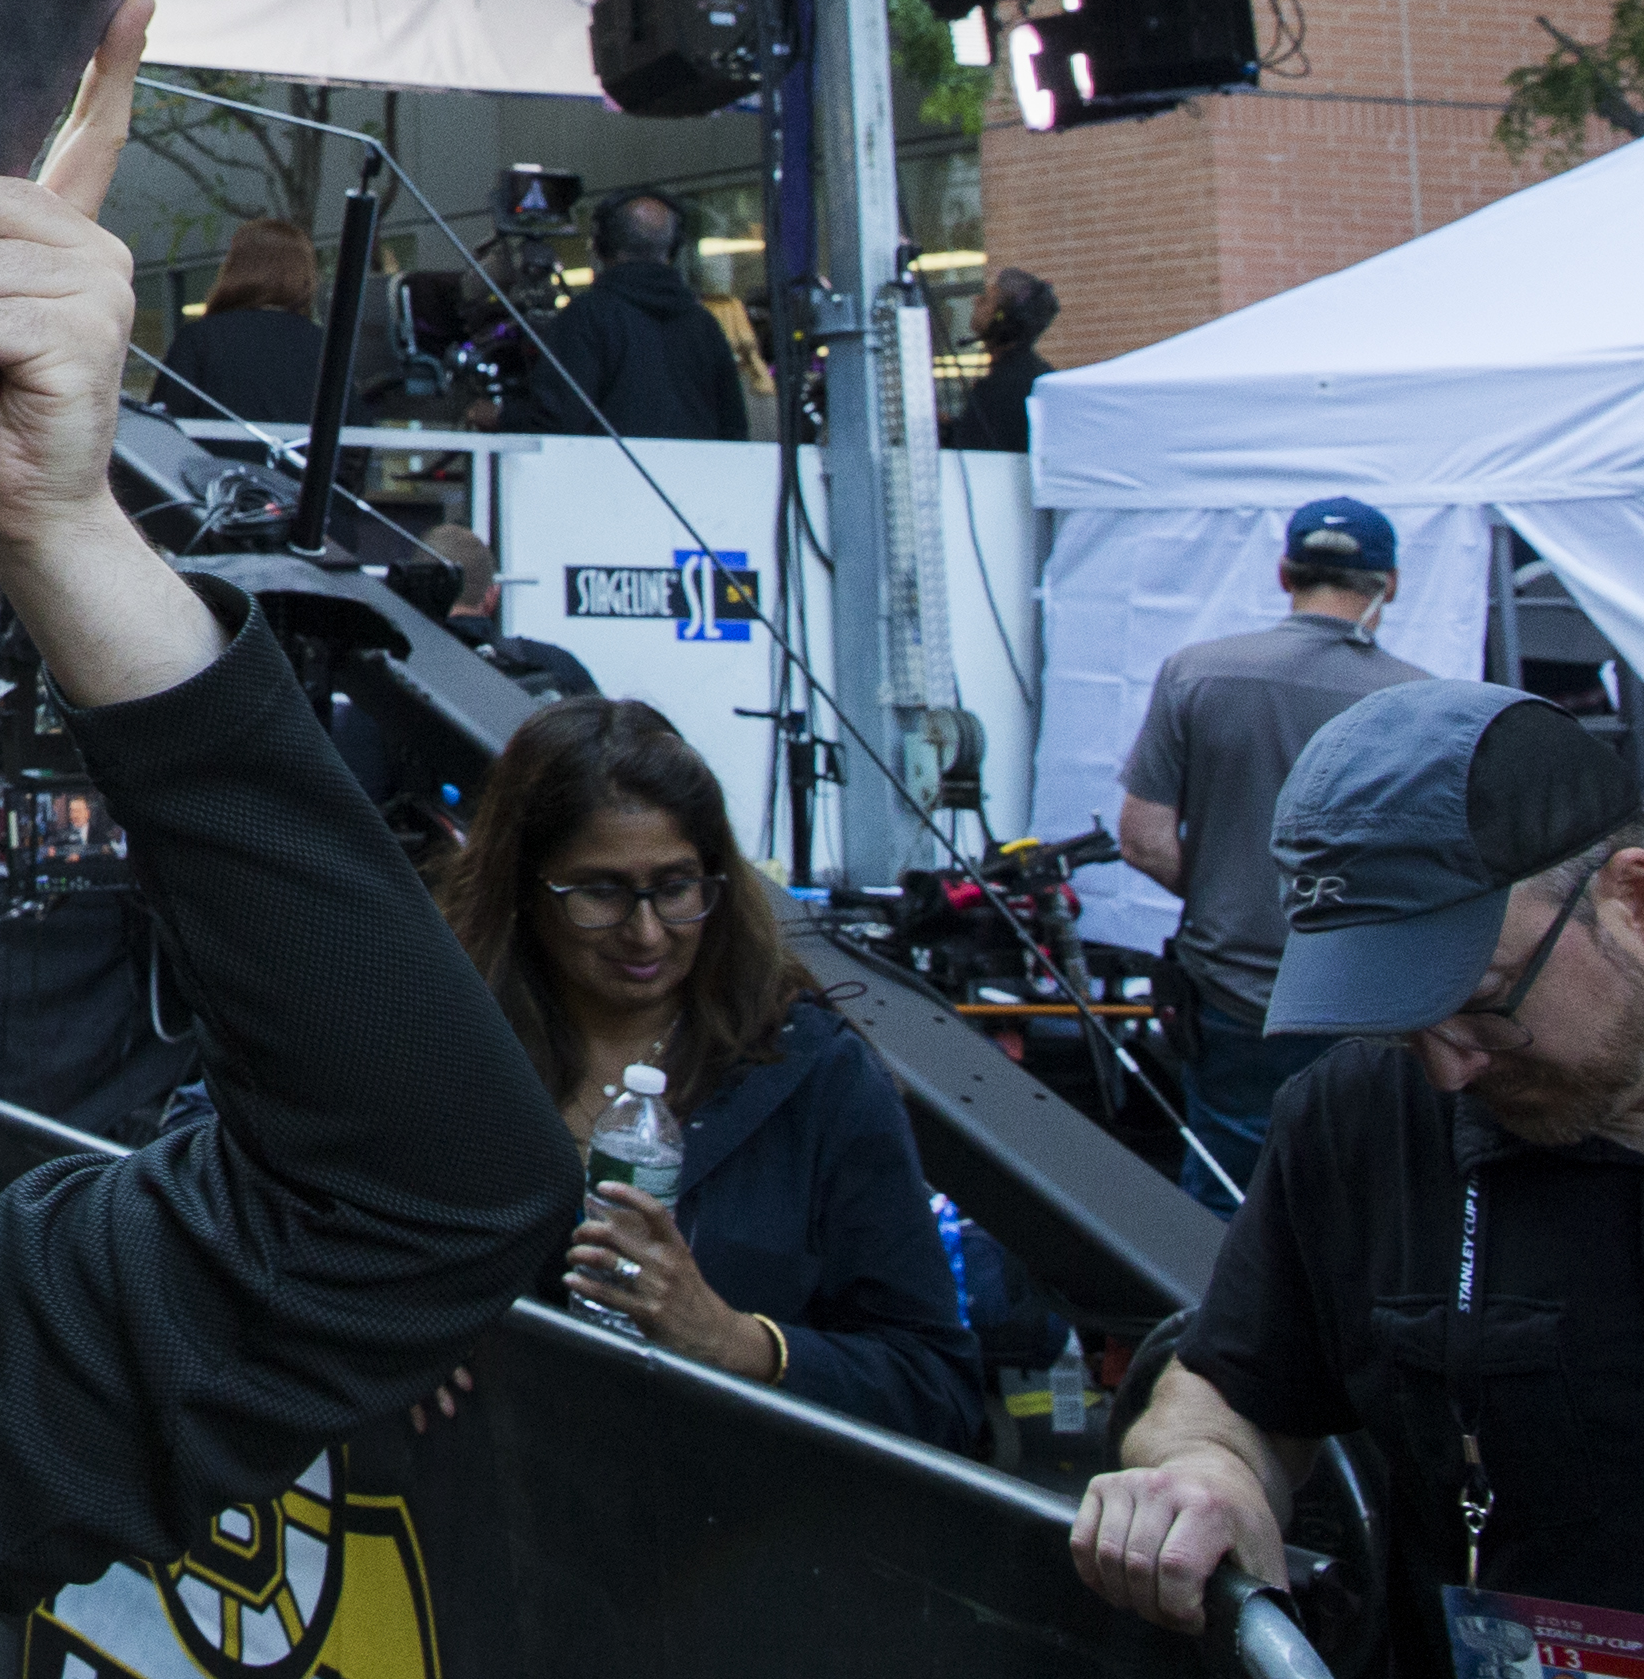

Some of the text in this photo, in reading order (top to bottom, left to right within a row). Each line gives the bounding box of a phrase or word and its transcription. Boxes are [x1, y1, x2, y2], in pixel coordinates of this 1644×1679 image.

[1464, 1198, 1478, 1235] CUP
[1458, 1235, 1476, 1313] STANLEY
[1534, 1626, 1608, 1646] STANLEY
